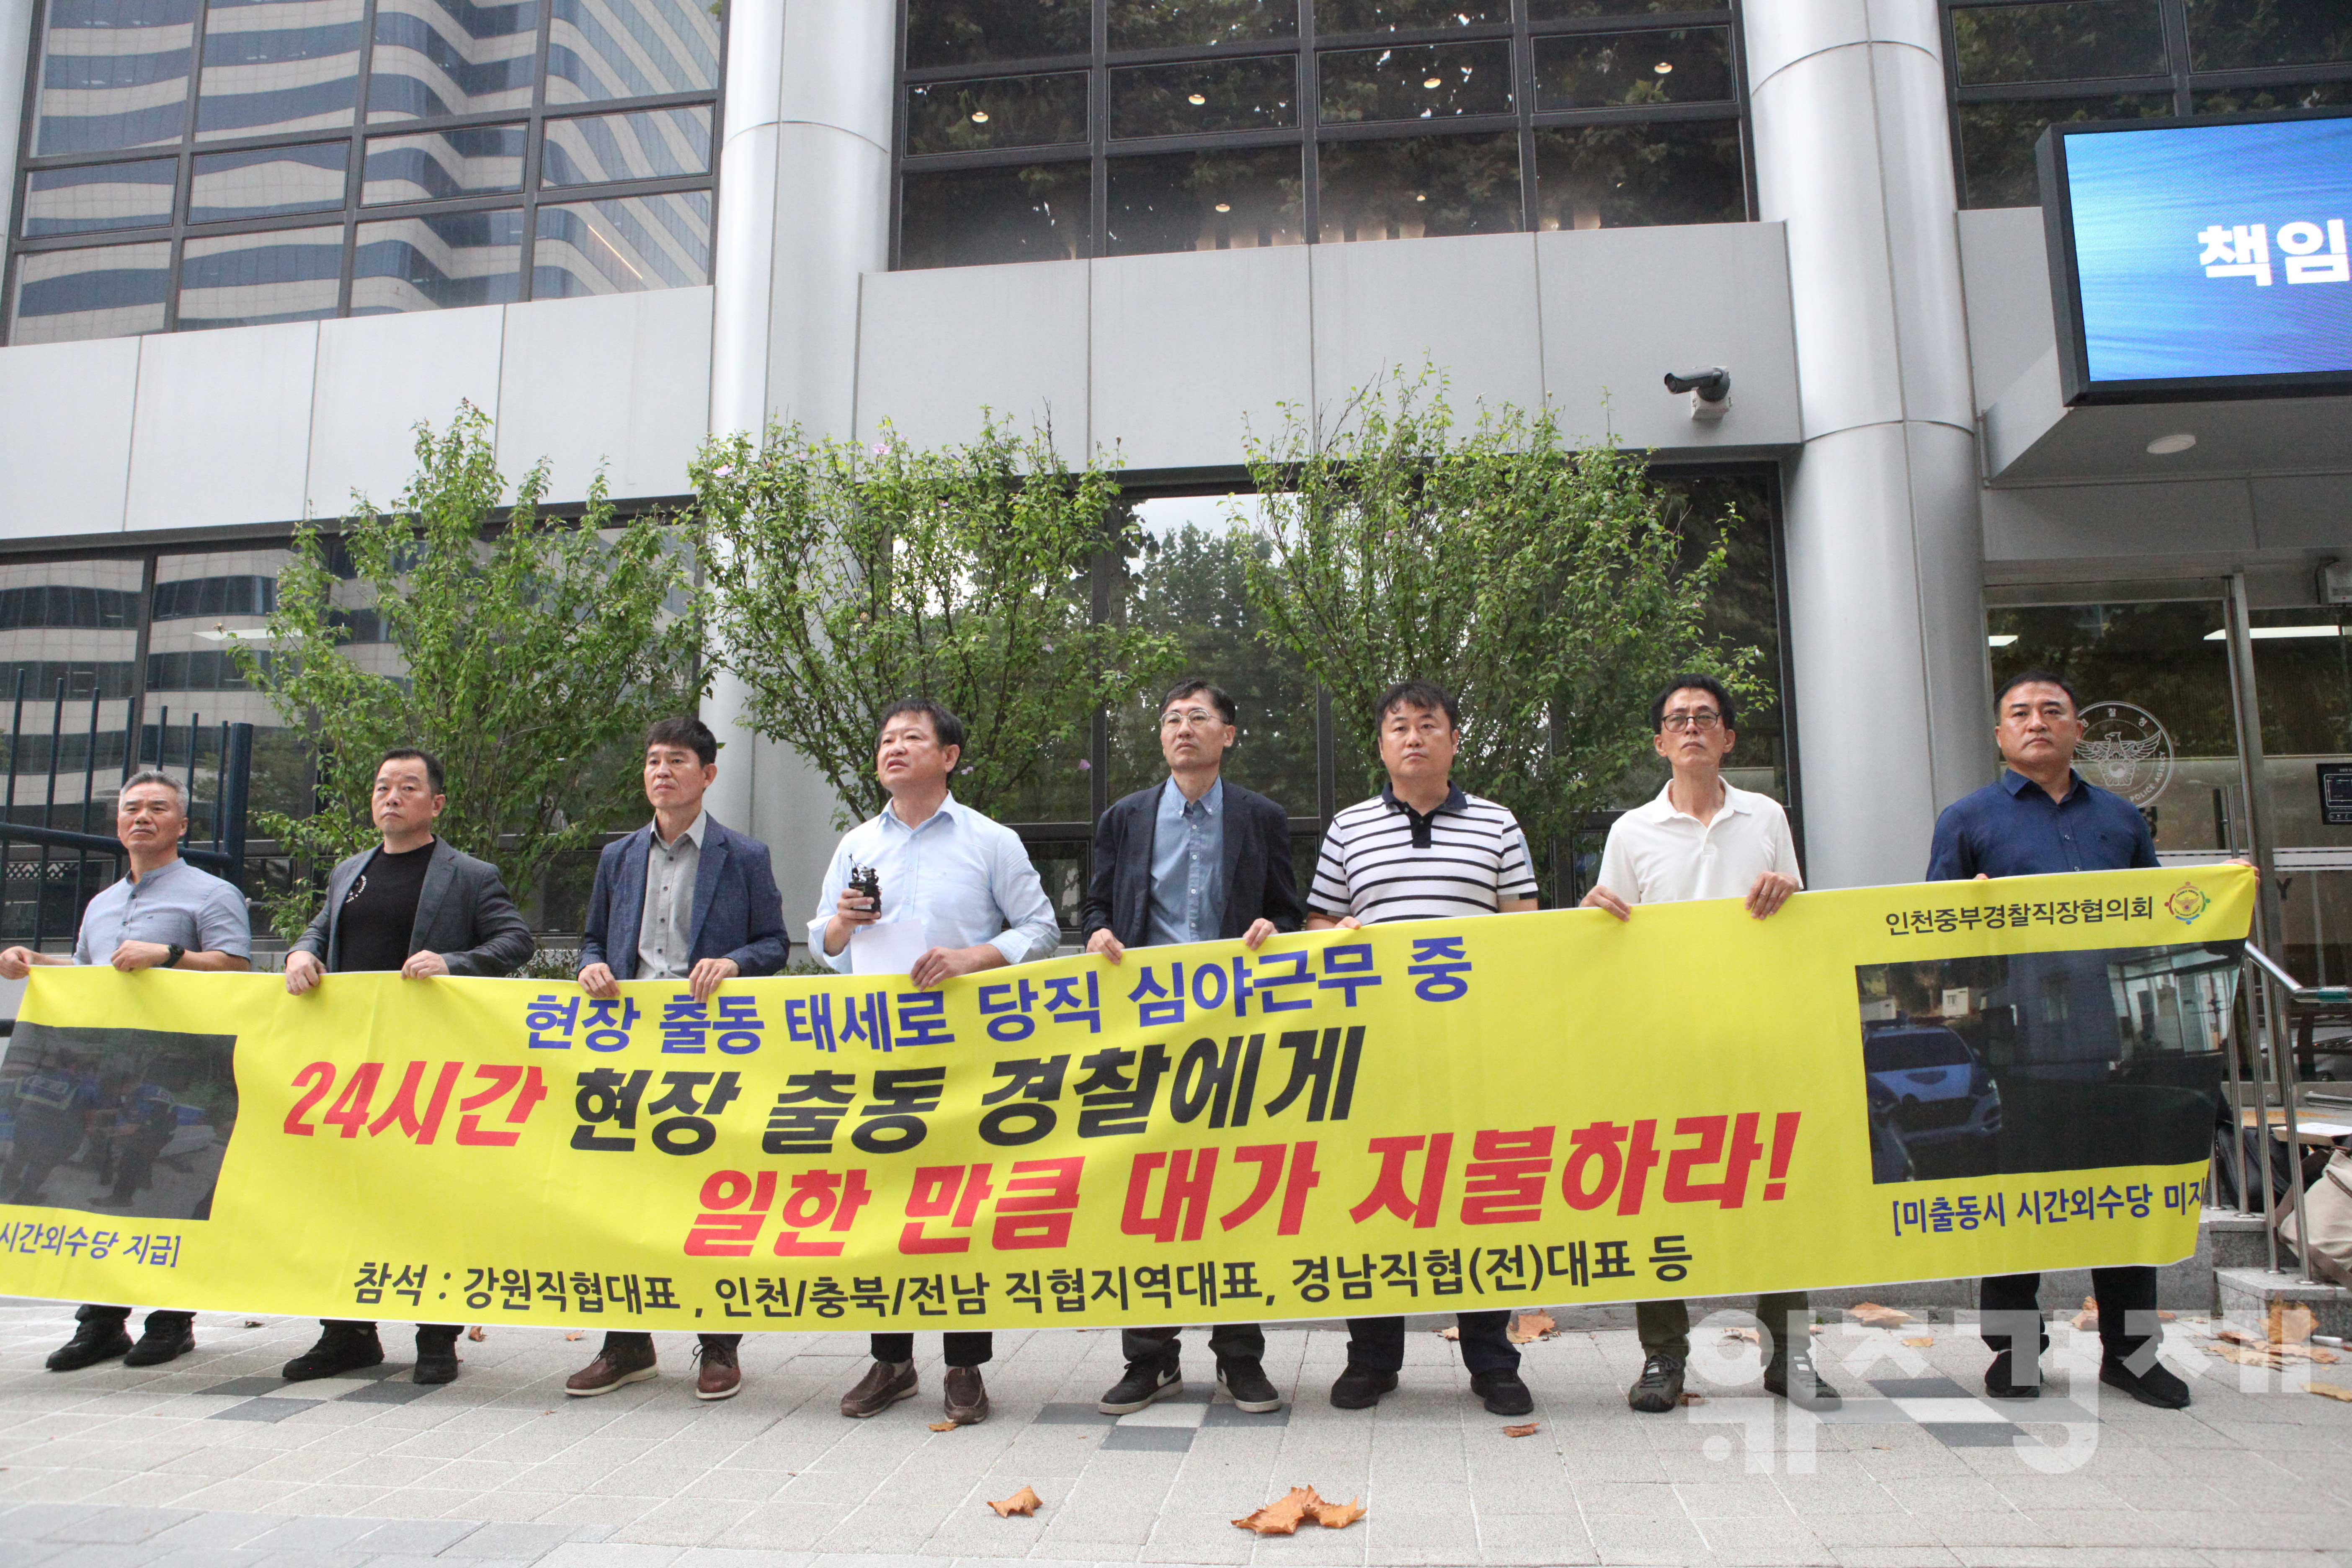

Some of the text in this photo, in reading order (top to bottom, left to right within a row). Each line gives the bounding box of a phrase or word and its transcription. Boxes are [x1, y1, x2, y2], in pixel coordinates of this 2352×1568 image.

[2197, 218, 2351, 286] 책임
[2130, 784, 2156, 802] POLICE
[2154, 751, 2166, 783] AGENCY
[1885, 896, 2153, 936] 인천중부경찰직장협의회
[526, 936, 1472, 1055] 현장 출동 태세로 당직 심야근무 중
[284, 1025, 1366, 1156] 24시간 현장 출동 경찰에게
[683, 1112, 1801, 1257] 일한 만큼 대가 지불하라!
[1893, 1192, 2005, 1236] [미출동시
[2017, 1184, 2153, 1224] 시간외수당
[123, 1234, 181, 1267] 지급]
[464, 1267, 680, 1315] 강원직협대표
[715, 1272, 990, 1318] 인천/충북/전남
[1005, 1261, 1275, 1314] 직협지역대표,
[1292, 1240, 1636, 1303] 경남직협(전)대표
[1648, 1235, 1693, 1282] 등
